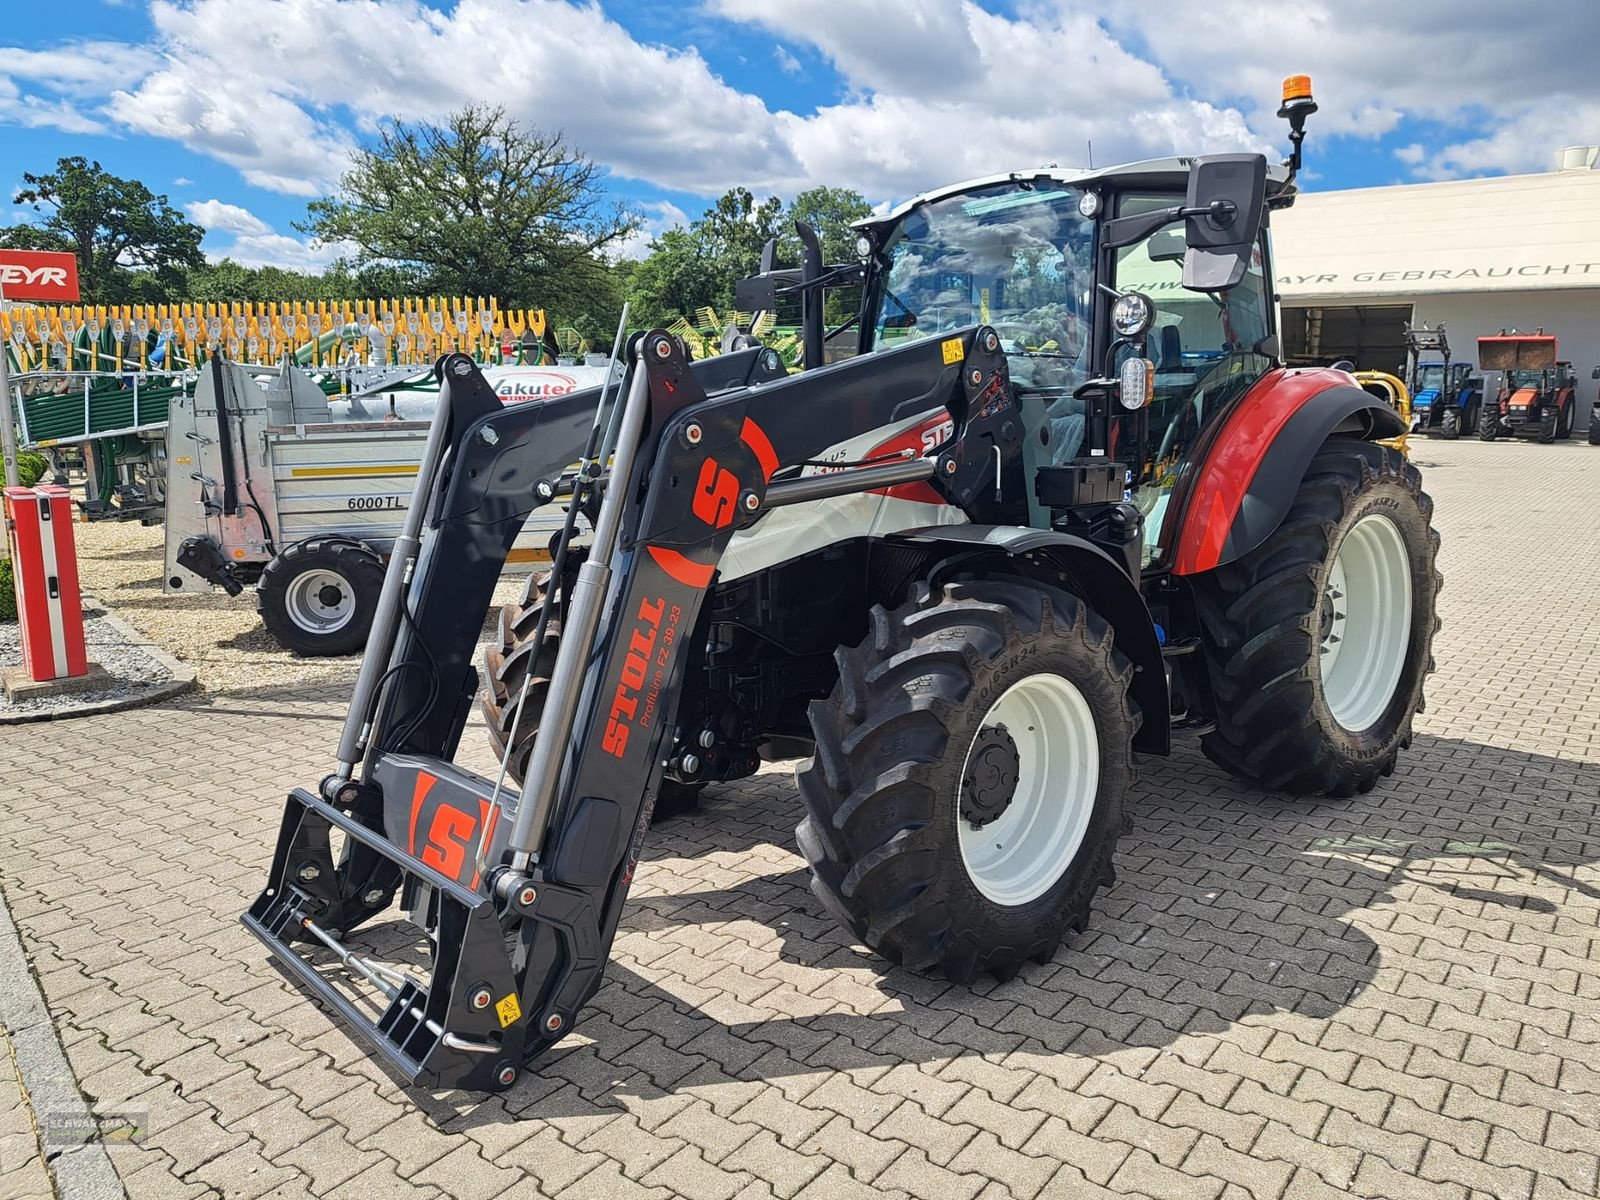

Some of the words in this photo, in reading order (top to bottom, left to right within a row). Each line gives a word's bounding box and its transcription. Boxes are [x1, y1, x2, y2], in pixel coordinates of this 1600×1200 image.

[0, 264, 67, 287] EYR
[348, 497, 383, 509] 6000
[385, 496, 403, 508] TL
[602, 597, 666, 758] STOLL
[640, 669, 664, 729] ProfiLine
[656, 646, 670, 668] FZ
[663, 605, 682, 646] 39-23
